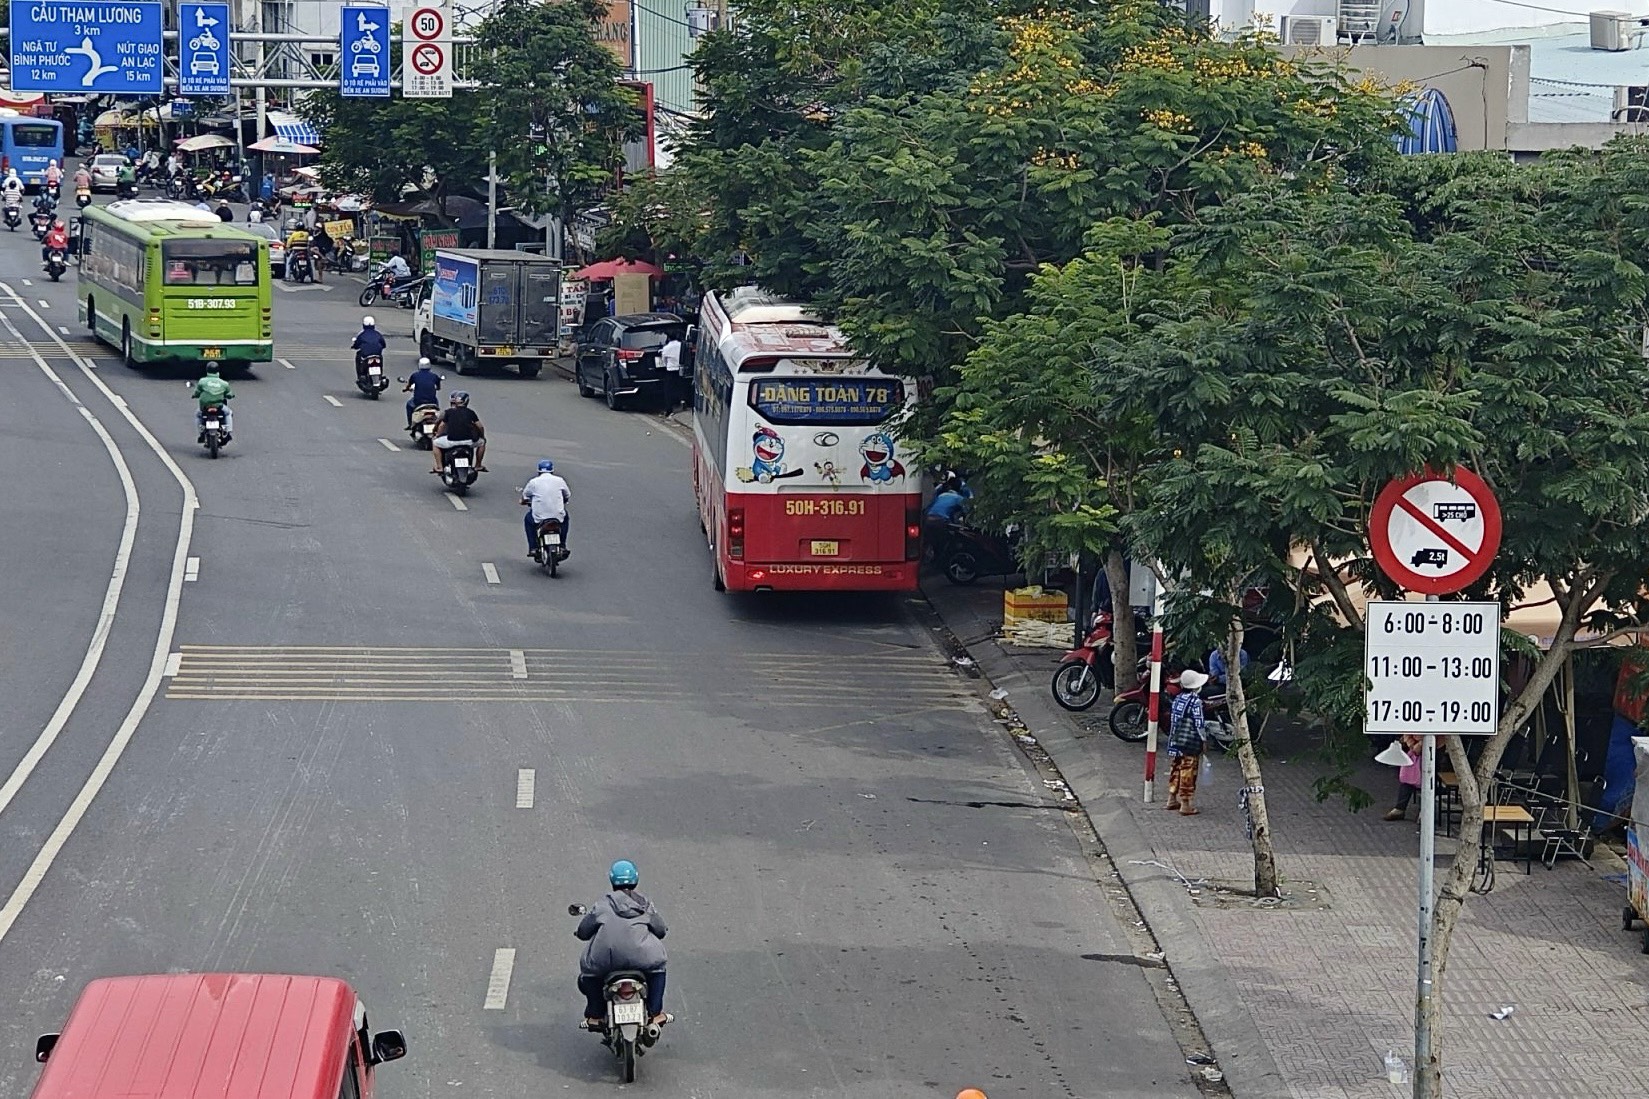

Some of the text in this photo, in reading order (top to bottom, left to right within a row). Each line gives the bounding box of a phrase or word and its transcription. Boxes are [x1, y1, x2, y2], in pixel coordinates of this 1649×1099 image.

[60, 7, 95, 22] THAM
[99, 6, 141, 23] LƯƠNG
[74, 25, 100, 35] 3 km
[421, 18, 434, 31] 50
[44, 41, 57, 52] TƯ
[117, 40, 136, 54] NÚT
[14, 52, 70, 66] BÌNH PHƯỚC
[121, 57, 155, 69] AN LẠC
[31, 69, 56, 80] 12 km
[126, 71, 150, 80] 15 km
[866, 388, 888, 403] 78
[786, 500, 865, 515] 50H-316.91
[770, 564, 882, 574] LUXURY EXPRESS
